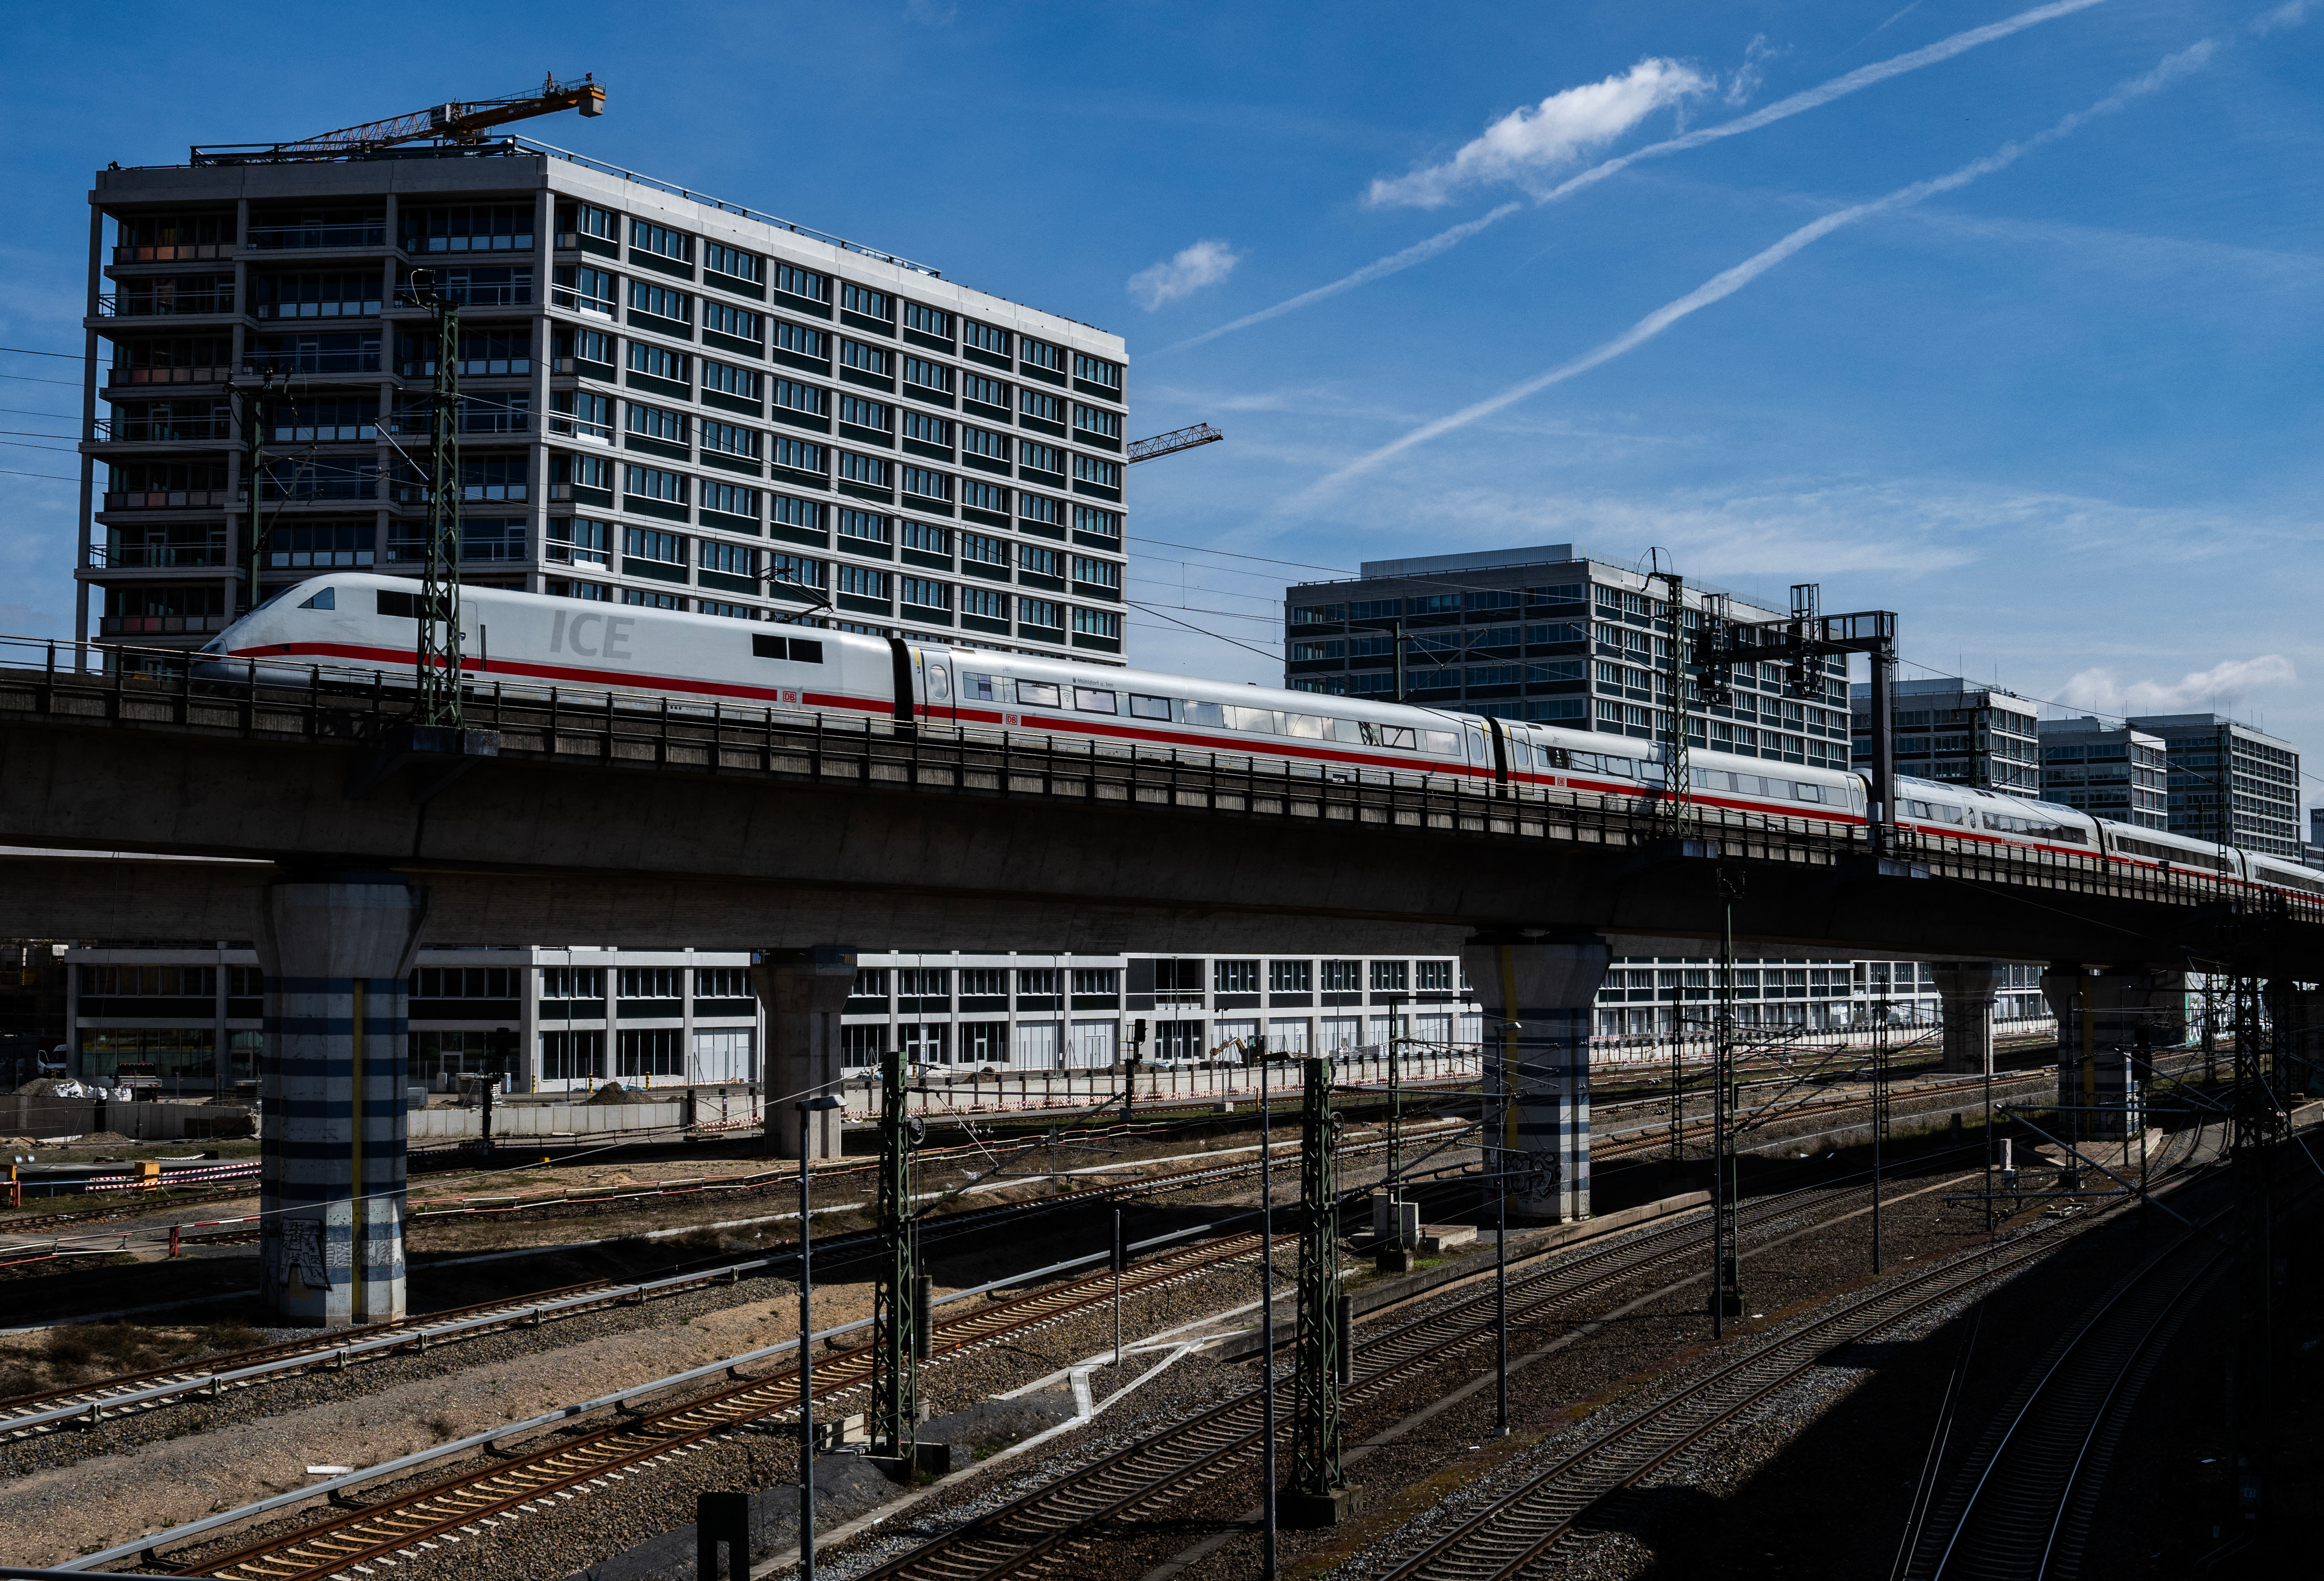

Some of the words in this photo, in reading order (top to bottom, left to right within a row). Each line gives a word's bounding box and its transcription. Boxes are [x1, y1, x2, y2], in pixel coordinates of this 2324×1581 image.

[431, 108, 446, 117] EC-B
[550, 610, 635, 660] ICE
[2003, 839, 2032, 848] Bordrestaurant
